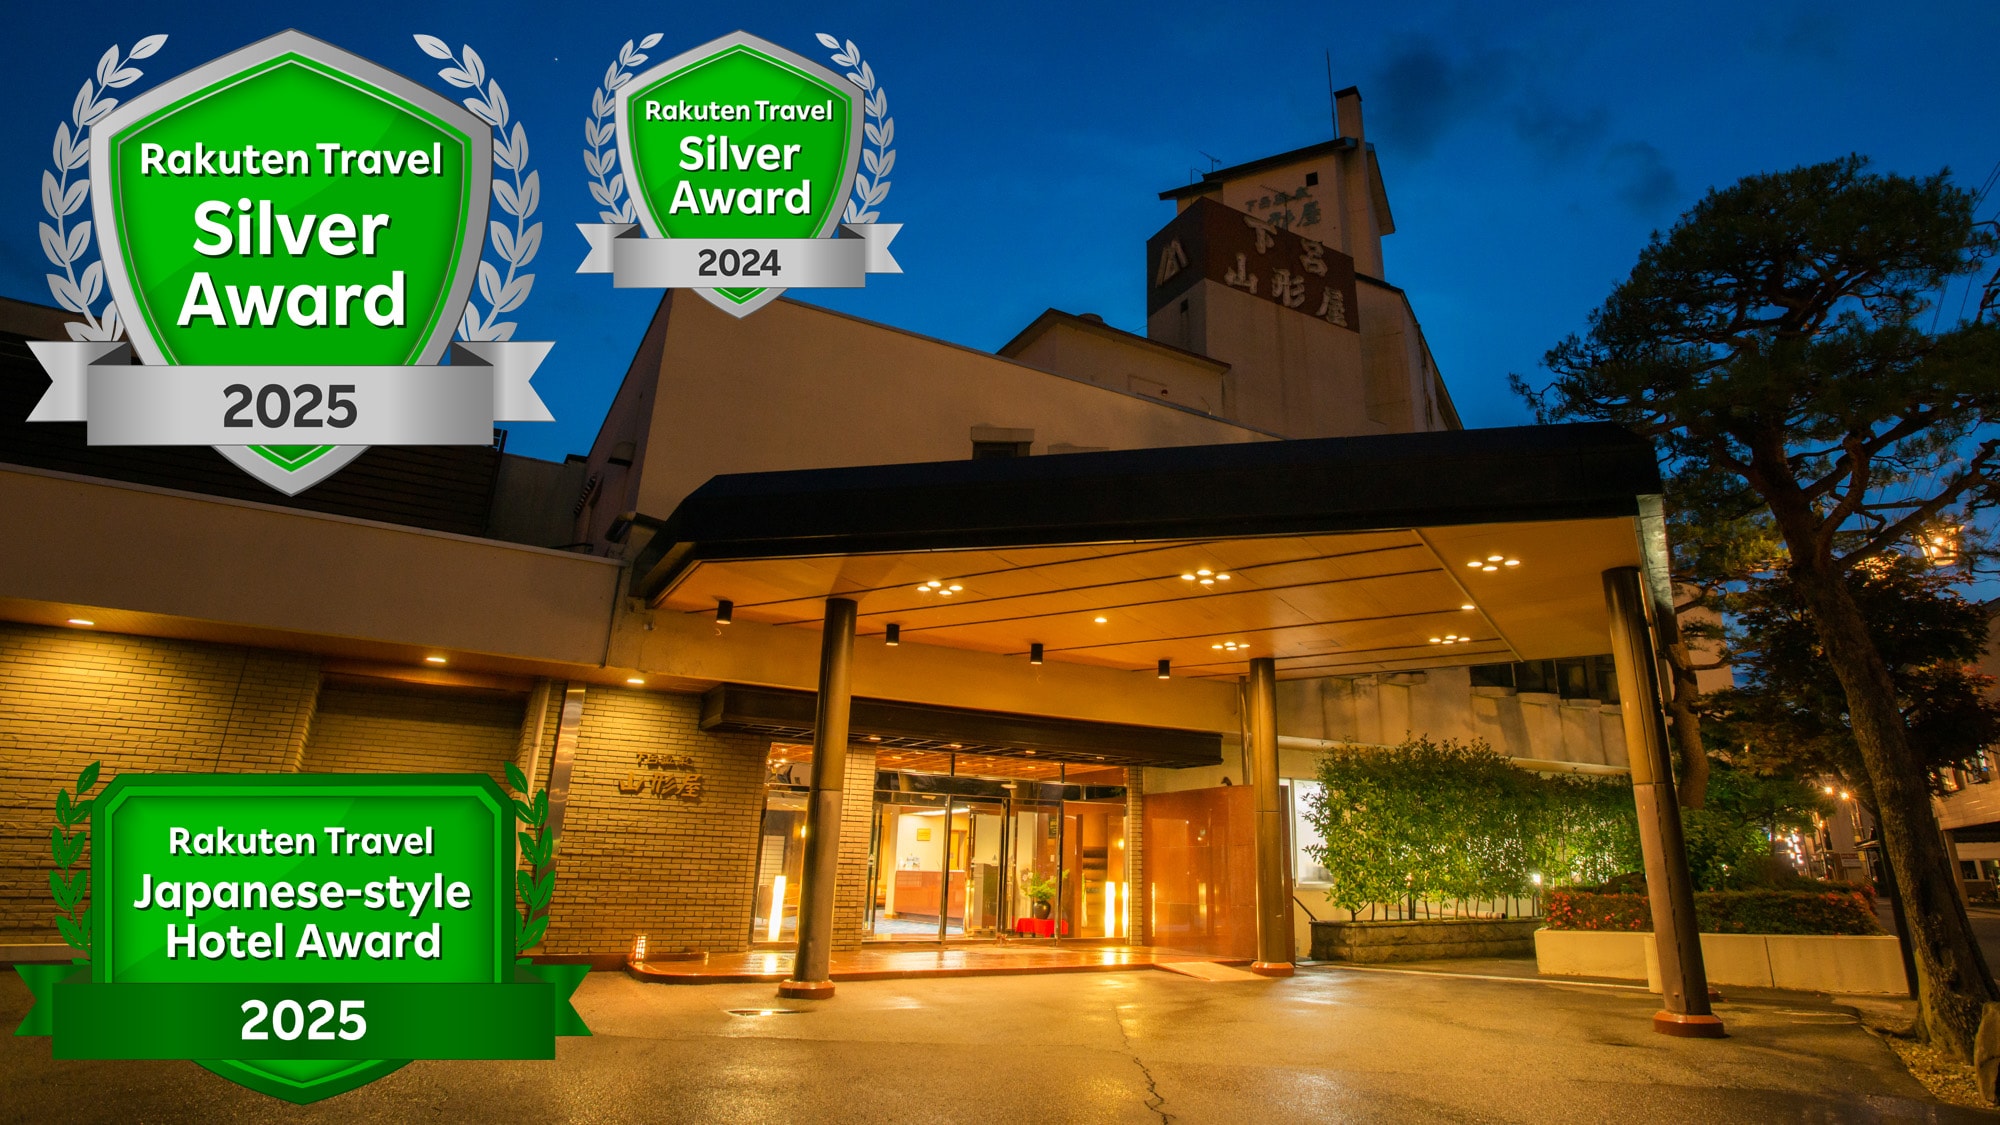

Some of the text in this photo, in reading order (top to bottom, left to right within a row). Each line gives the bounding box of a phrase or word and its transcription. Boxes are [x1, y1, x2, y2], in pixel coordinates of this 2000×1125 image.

[1225, 253, 1347, 327] 山形屋
[619, 771, 702, 798] 山形屋
